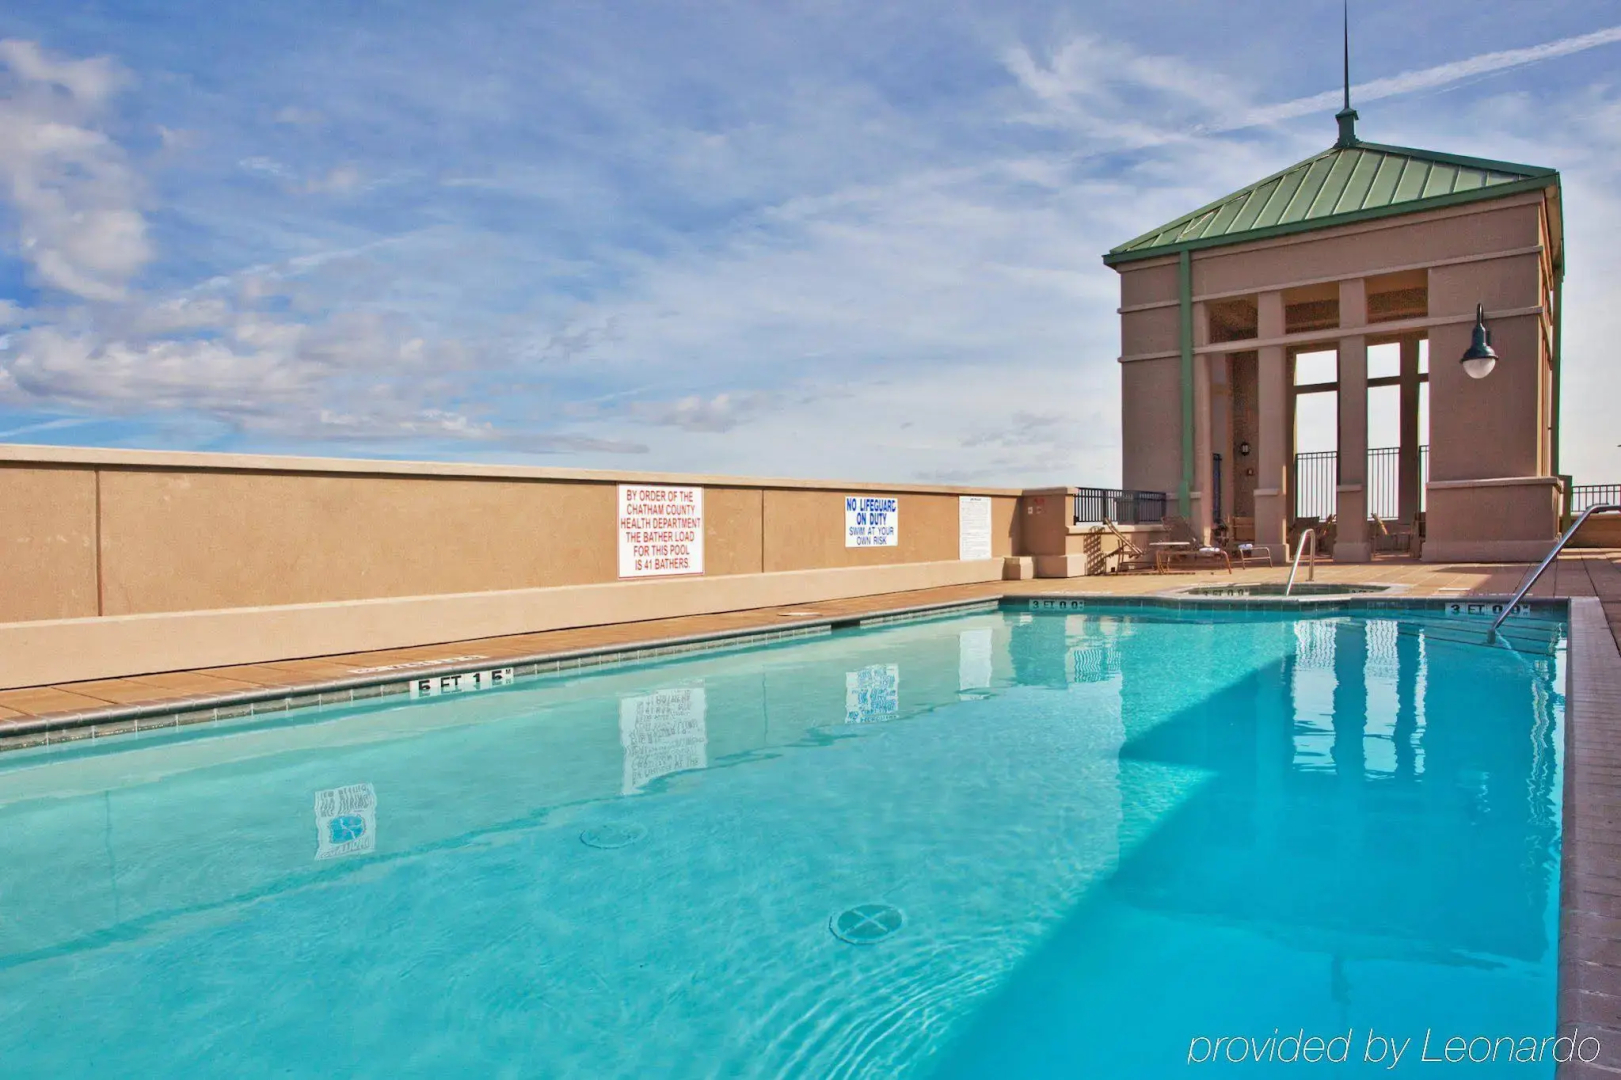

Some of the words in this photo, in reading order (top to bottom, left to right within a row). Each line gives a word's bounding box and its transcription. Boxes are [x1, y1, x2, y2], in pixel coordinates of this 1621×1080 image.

[626, 489, 637, 501] BY
[639, 490, 666, 502] ORDER
[667, 491, 678, 502] OF
[679, 491, 694, 502] THE
[626, 503, 664, 515] CHATHAM
[665, 504, 696, 515] COUNTY
[846, 497, 857, 511] NO
[620, 517, 651, 529] HEALTH
[652, 517, 701, 529] DEPARTMENT
[856, 512, 867, 525] ON
[869, 512, 887, 525] DUTY
[625, 531, 641, 543] THE
[643, 531, 673, 543] BATHER
[674, 531, 695, 542] LOAD
[849, 526, 865, 536] SWIM
[867, 526, 876, 535] AT
[878, 526, 894, 536] YOUR
[856, 536, 871, 546] OWN
[873, 536, 887, 545] RISK
[633, 545, 650, 557] FOR
[651, 545, 668, 556] THIS
[669, 544, 690, 555] POOL
[634, 559, 643, 571] IS
[644, 559, 652, 570] 41
[654, 558, 690, 570] BATHERS.
[440, 675, 462, 688] FT
[473, 673, 480, 683] 1
